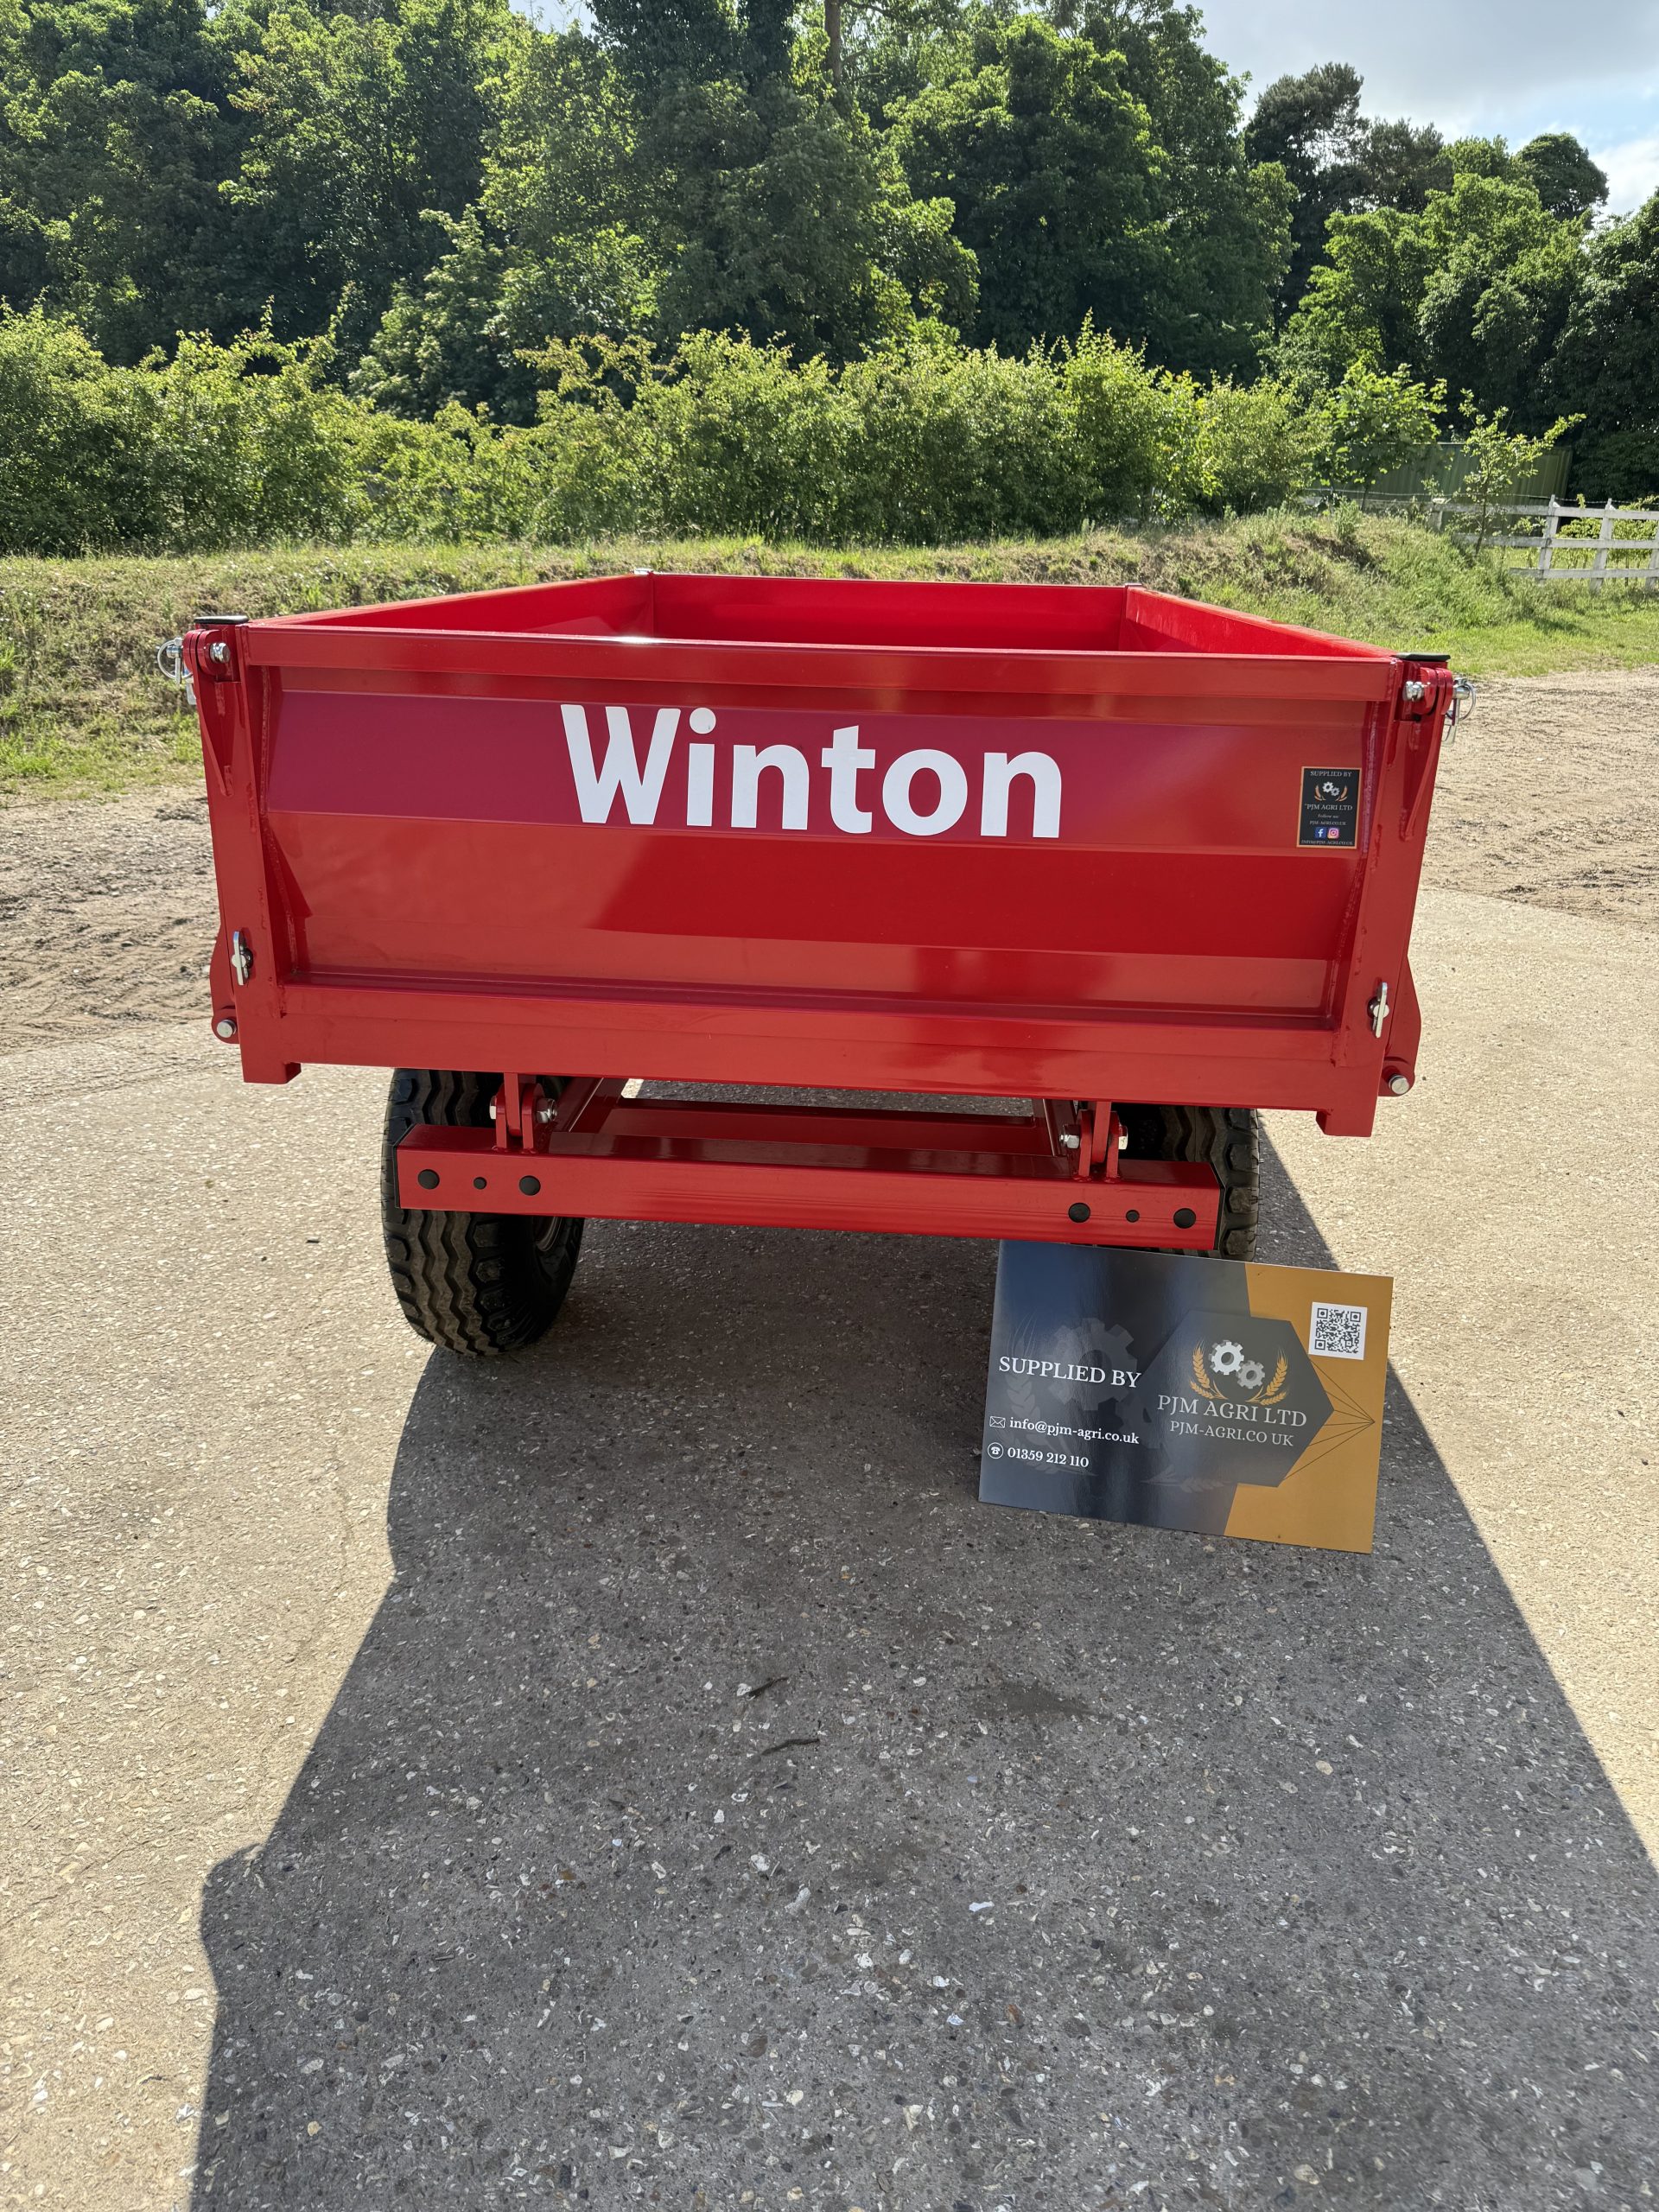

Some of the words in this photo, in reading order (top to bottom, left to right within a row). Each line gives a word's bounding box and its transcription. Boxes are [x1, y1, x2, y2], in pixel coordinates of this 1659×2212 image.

[560, 703, 1062, 838] Winton
[999, 1356, 1106, 1383] SUPPLIED
[1110, 1369, 1142, 1389] BY
[1157, 1395, 1199, 1415] PJM
[1204, 1401, 1259, 1421] AGRI
[1264, 1408, 1307, 1427] LTD
[1009, 1416, 1140, 1445] info@pjm-agri.co.uk
[1170, 1421, 1268, 1443] PJM-AGRI.CO
[1271, 1433, 1295, 1446] UK
[1007, 1446, 1044, 1462] 01359
[1046, 1452, 1068, 1465] 212
[1070, 1455, 1090, 1468] 110
